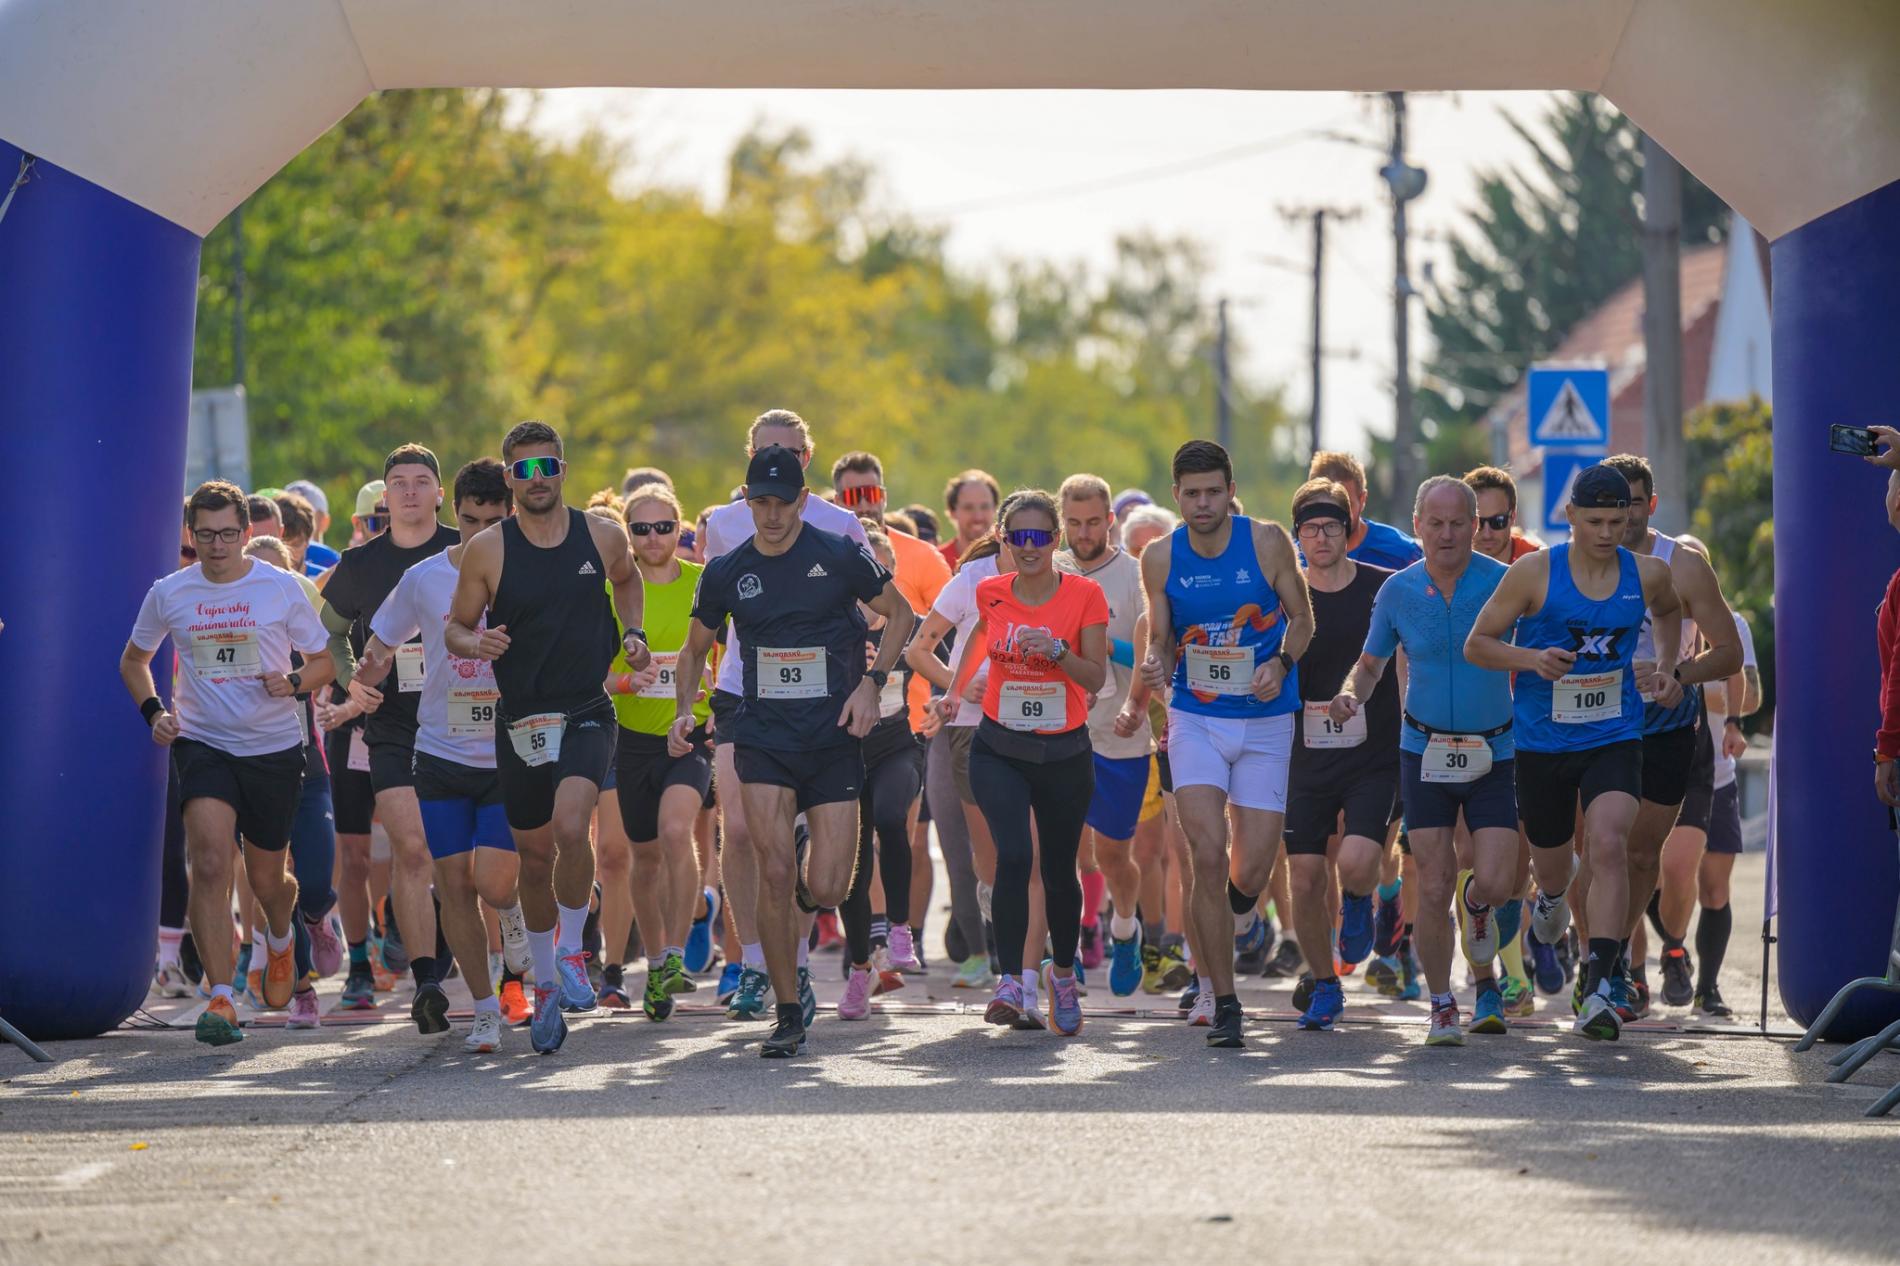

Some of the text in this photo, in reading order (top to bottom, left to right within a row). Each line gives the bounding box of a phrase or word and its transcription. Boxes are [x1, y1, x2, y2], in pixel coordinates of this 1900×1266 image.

[216, 648, 235, 662] 47
[763, 649, 801, 658] VAJNORSKÝ
[660, 669, 676, 684] 91
[780, 667, 801, 683] 93
[1209, 664, 1230, 680] 56
[1574, 691, 1605, 708] 100
[472, 706, 492, 721] 59
[1022, 701, 1043, 717] 69
[1323, 719, 1343, 733] 19
[531, 732, 545, 750] 55
[1446, 753, 1468, 768] 30
